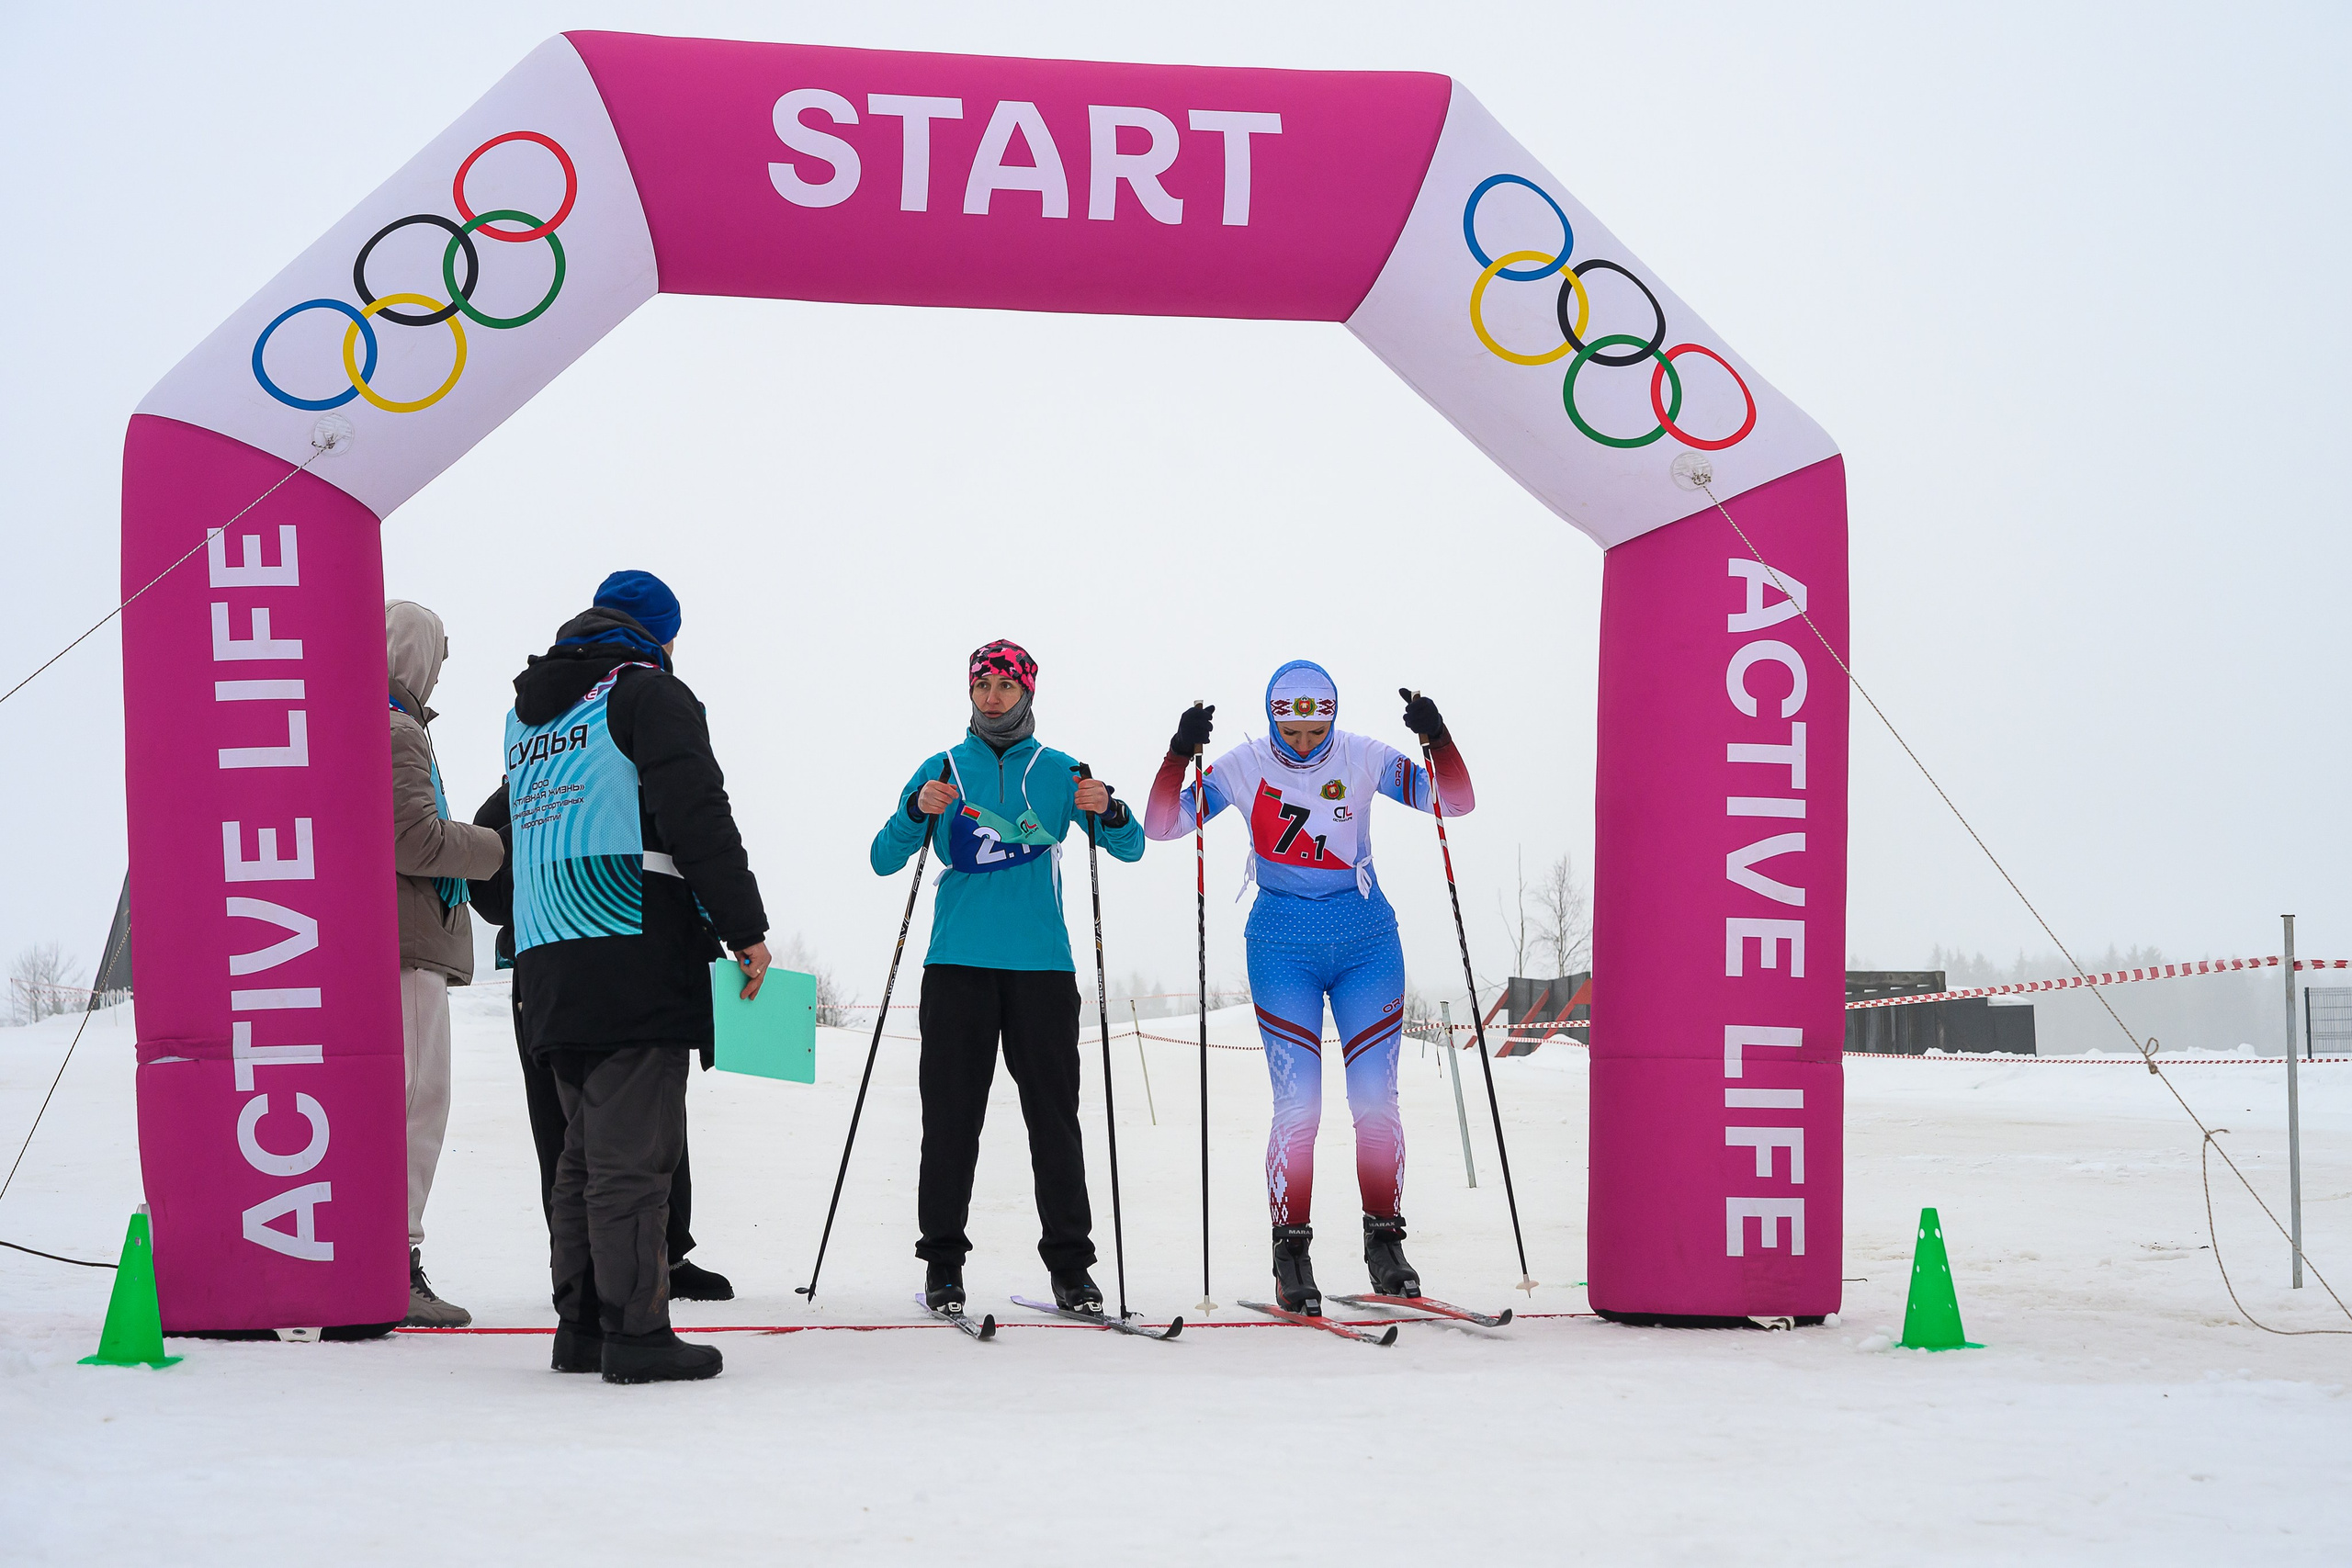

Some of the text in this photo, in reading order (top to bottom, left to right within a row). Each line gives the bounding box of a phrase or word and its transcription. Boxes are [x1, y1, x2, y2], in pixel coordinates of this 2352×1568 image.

[769, 89, 1282, 225] START
[508, 724, 589, 771] СУДЬЯ
[513, 791, 547, 807] КТИВНАЯ
[208, 525, 334, 1260] ACTIVE LIFE
[1724, 558, 1807, 1256] ACTIVE LIFE
